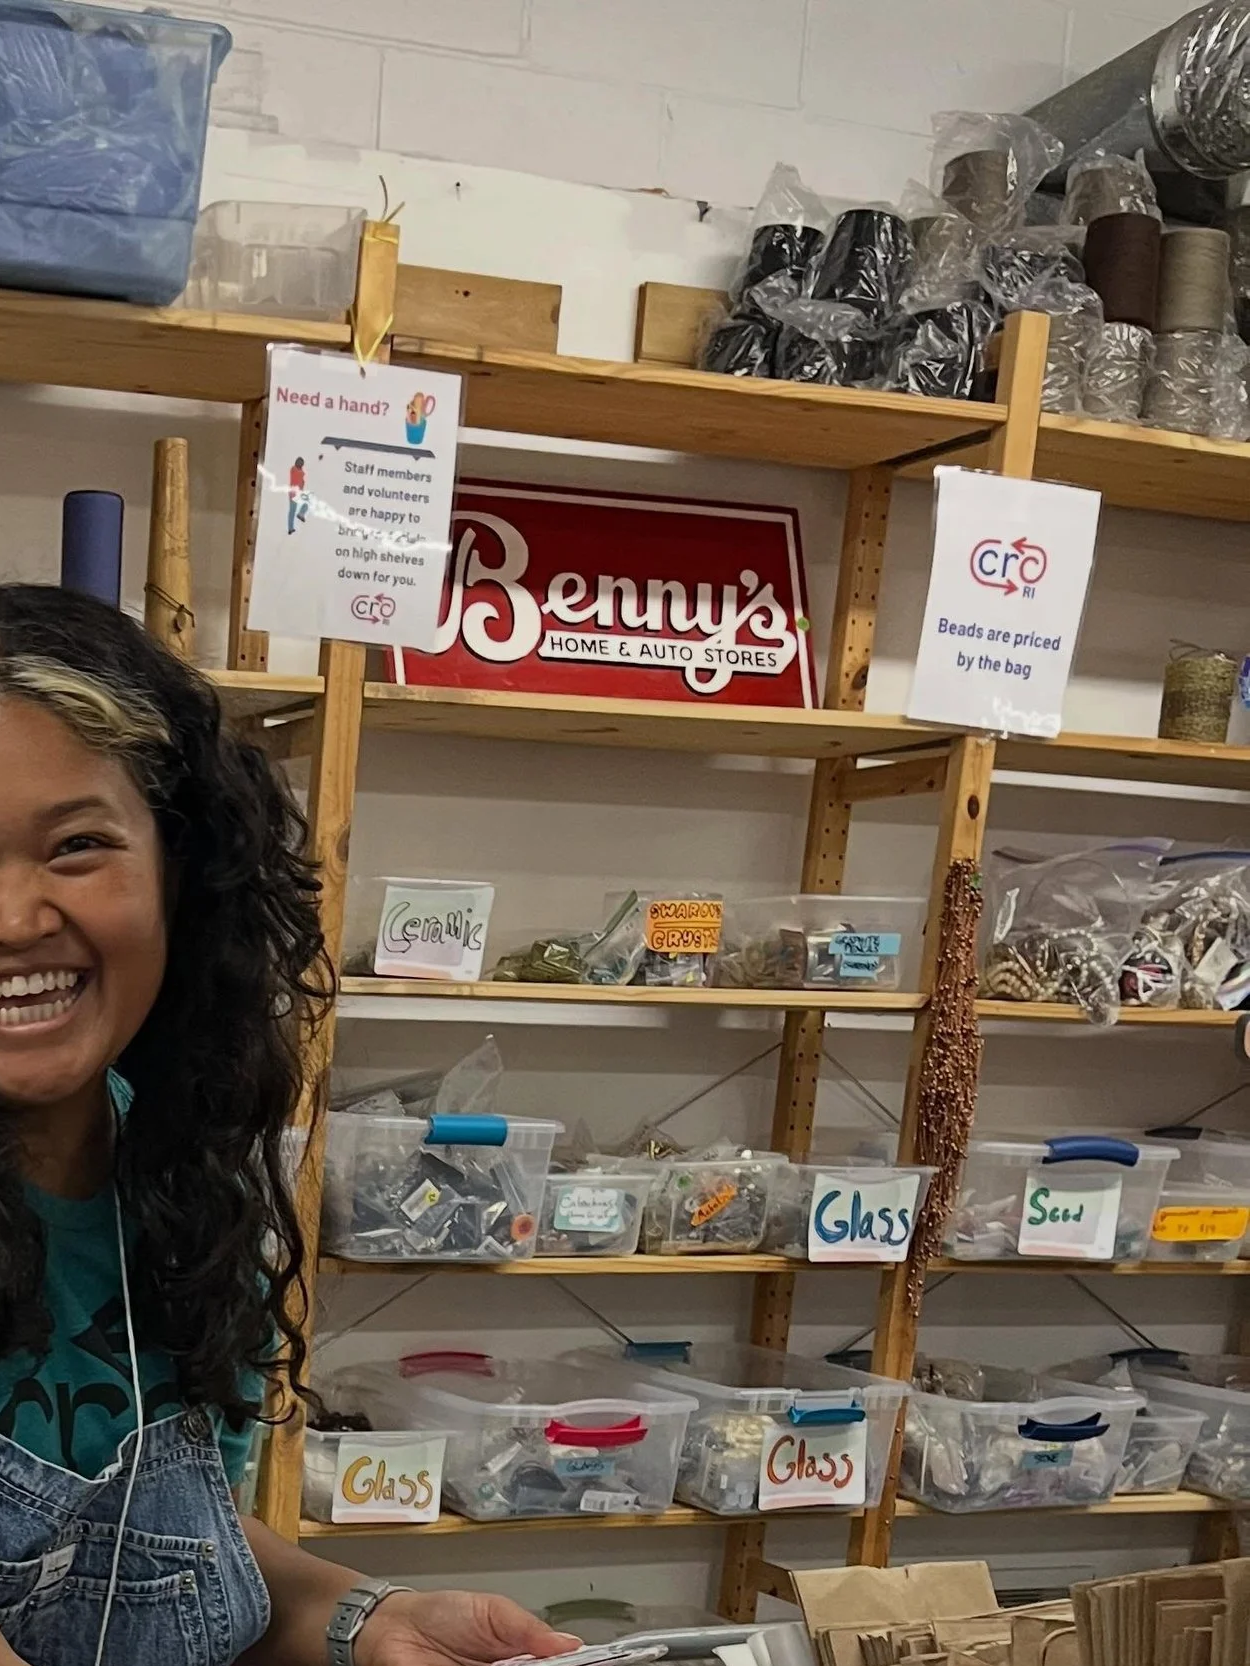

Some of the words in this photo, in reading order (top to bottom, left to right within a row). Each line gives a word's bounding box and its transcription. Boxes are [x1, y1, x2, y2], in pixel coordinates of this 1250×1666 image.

[276, 387, 320, 408] Need
[325, 397, 334, 410] a
[339, 395, 390, 417] hand?
[344, 461, 375, 477] Staff
[377, 466, 432, 484] members
[343, 484, 365, 497] and
[367, 486, 430, 504] volunteers
[348, 506, 368, 518] are
[370, 507, 405, 524] happy
[408, 512, 421, 524] to
[335, 547, 350, 558] on
[352, 546, 378, 562] high
[380, 551, 425, 566] shelves
[337, 568, 370, 581] down
[372, 571, 390, 583] for
[392, 574, 417, 588] you.
[1022, 586, 1036, 599] RI
[440, 510, 798, 694] Benny's
[938, 618, 984, 639] Beads
[987, 628, 1010, 643] are
[1013, 631, 1061, 652] priced
[550, 635, 609, 656] HOME
[618, 641, 631, 657] &
[639, 643, 694, 662] AUTO
[704, 649, 778, 668] STORES
[956, 651, 975, 670] by
[978, 655, 1001, 672] the
[1004, 662, 1032, 680] bag
[813, 1189, 912, 1244] Glass
[766, 1434, 855, 1489] Glass
[342, 1455, 434, 1510] Glass
